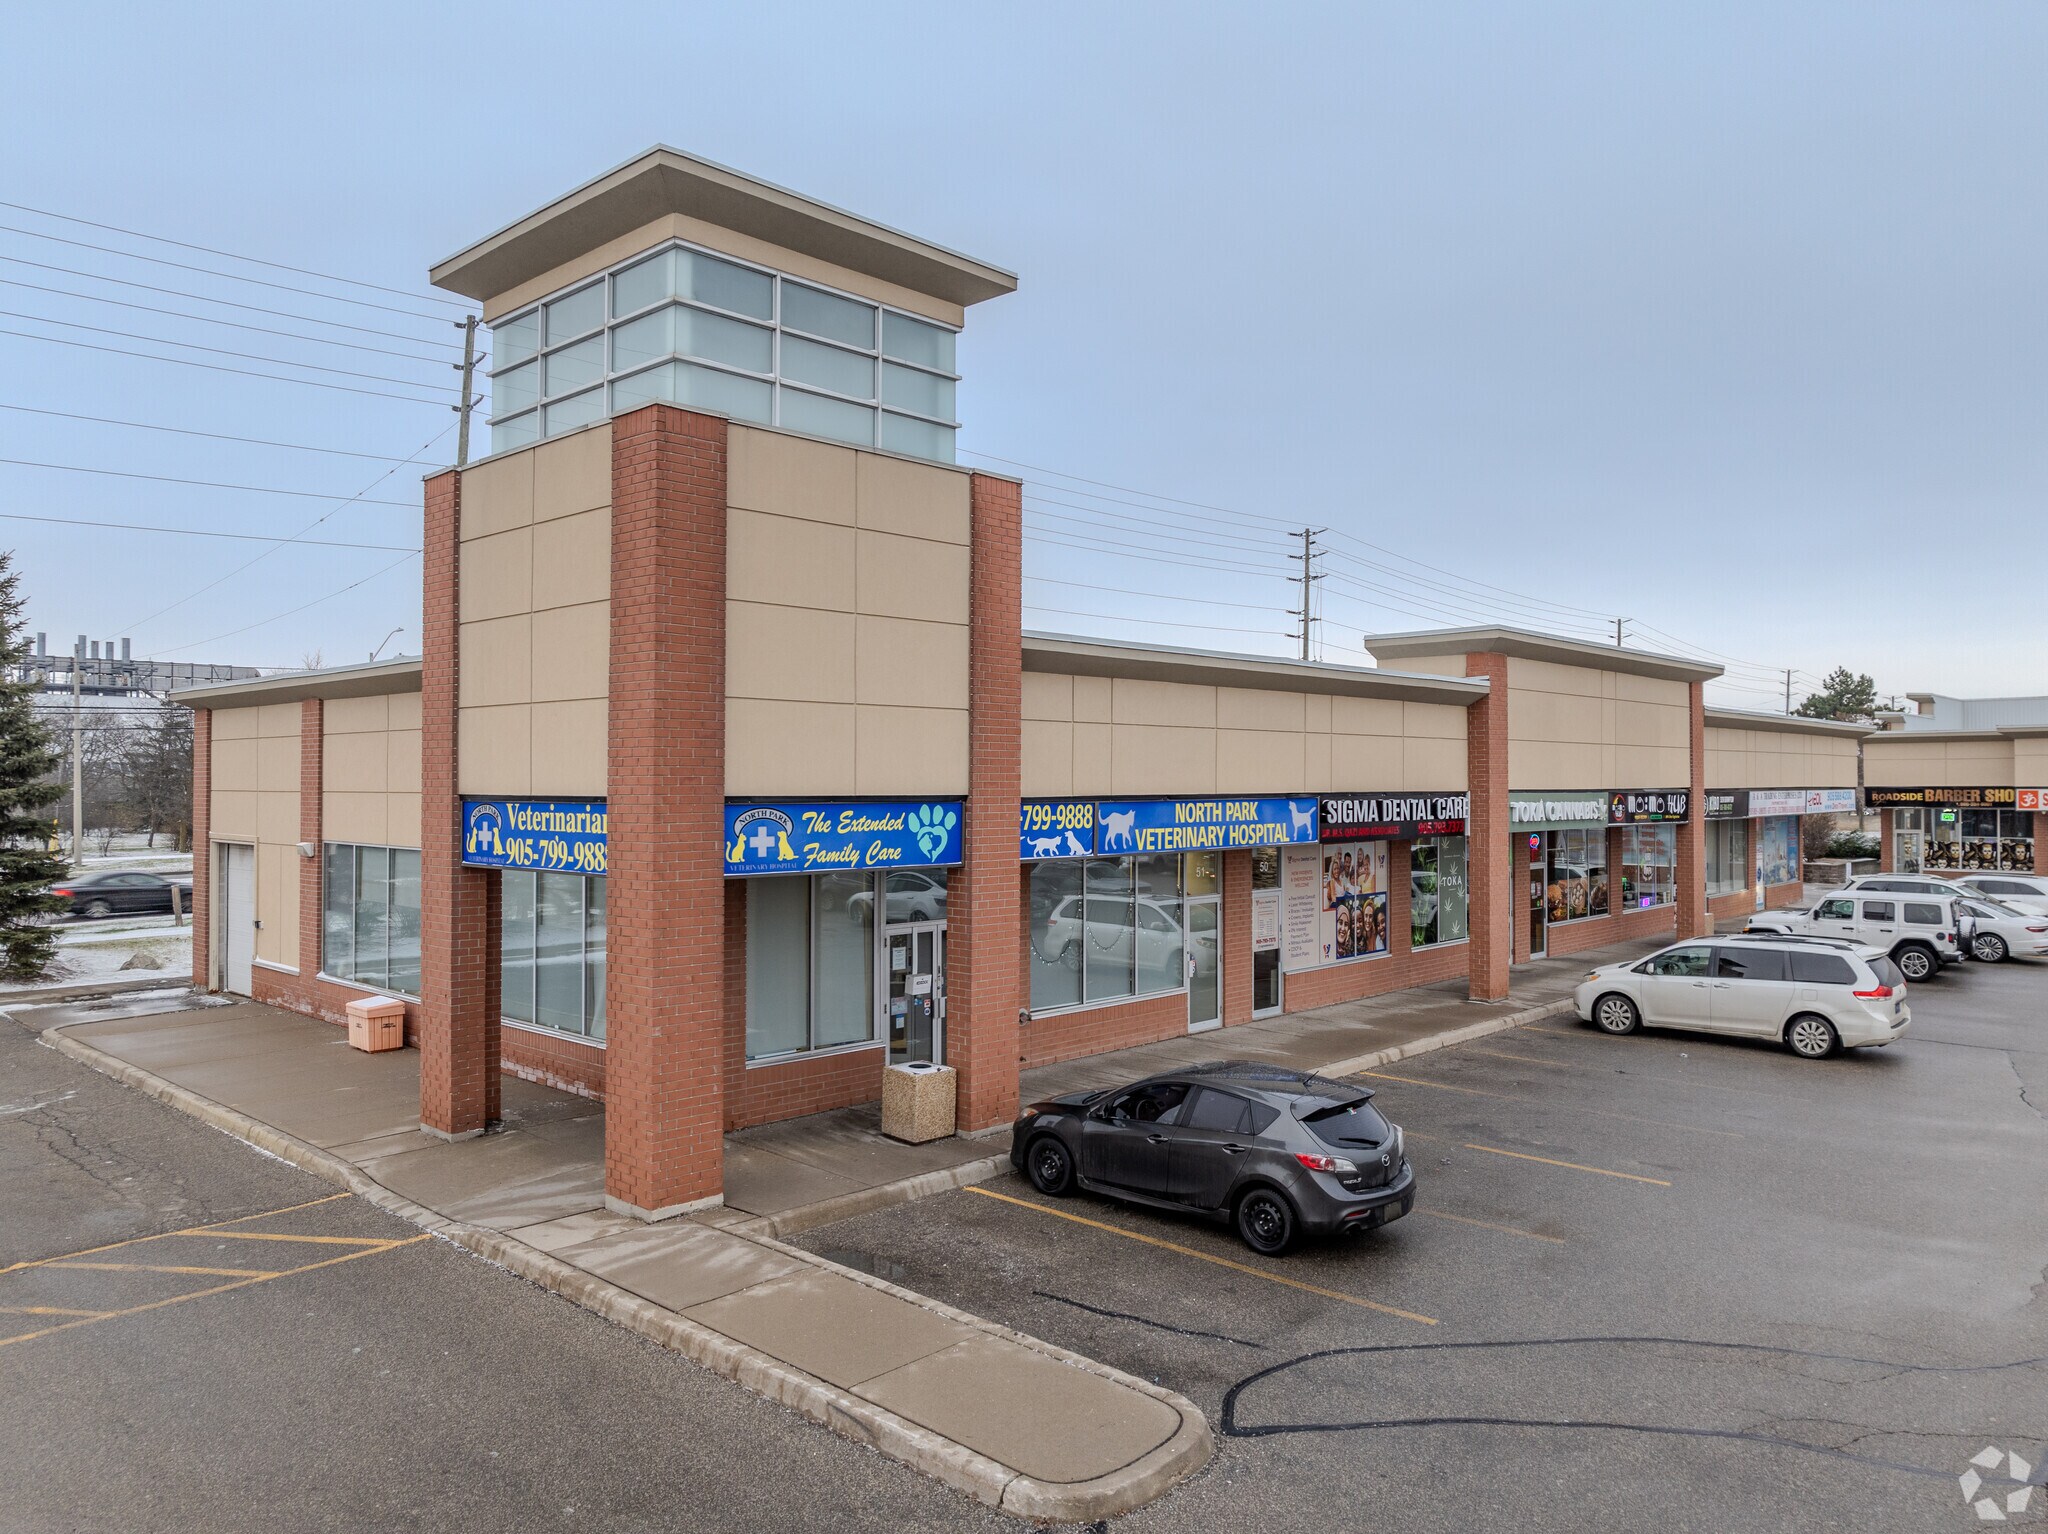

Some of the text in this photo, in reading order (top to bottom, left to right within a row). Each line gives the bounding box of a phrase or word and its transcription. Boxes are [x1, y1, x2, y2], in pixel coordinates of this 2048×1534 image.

[1667, 794, 1686, 814] HUB
[1872, 792, 1923, 801] ROADSIDE
[1924, 788, 1980, 802] BARBER
[739, 810, 790, 826] NORTH PARK
[802, 810, 905, 834] The Extended
[1175, 801, 1259, 824] NORTH PARK
[1326, 797, 1469, 824] SIGMA DENTAL CARE
[1510, 799, 1600, 823] TOKA CANNABIS
[1135, 823, 1290, 851] VETERINARY HOSPITAL
[506, 837, 608, 871] 905-799-988
[803, 840, 902, 868] Family Care
[1196, 866, 1205, 878] 51
[1259, 861, 1269, 872] 50
[1442, 875, 1463, 886] TOKA
